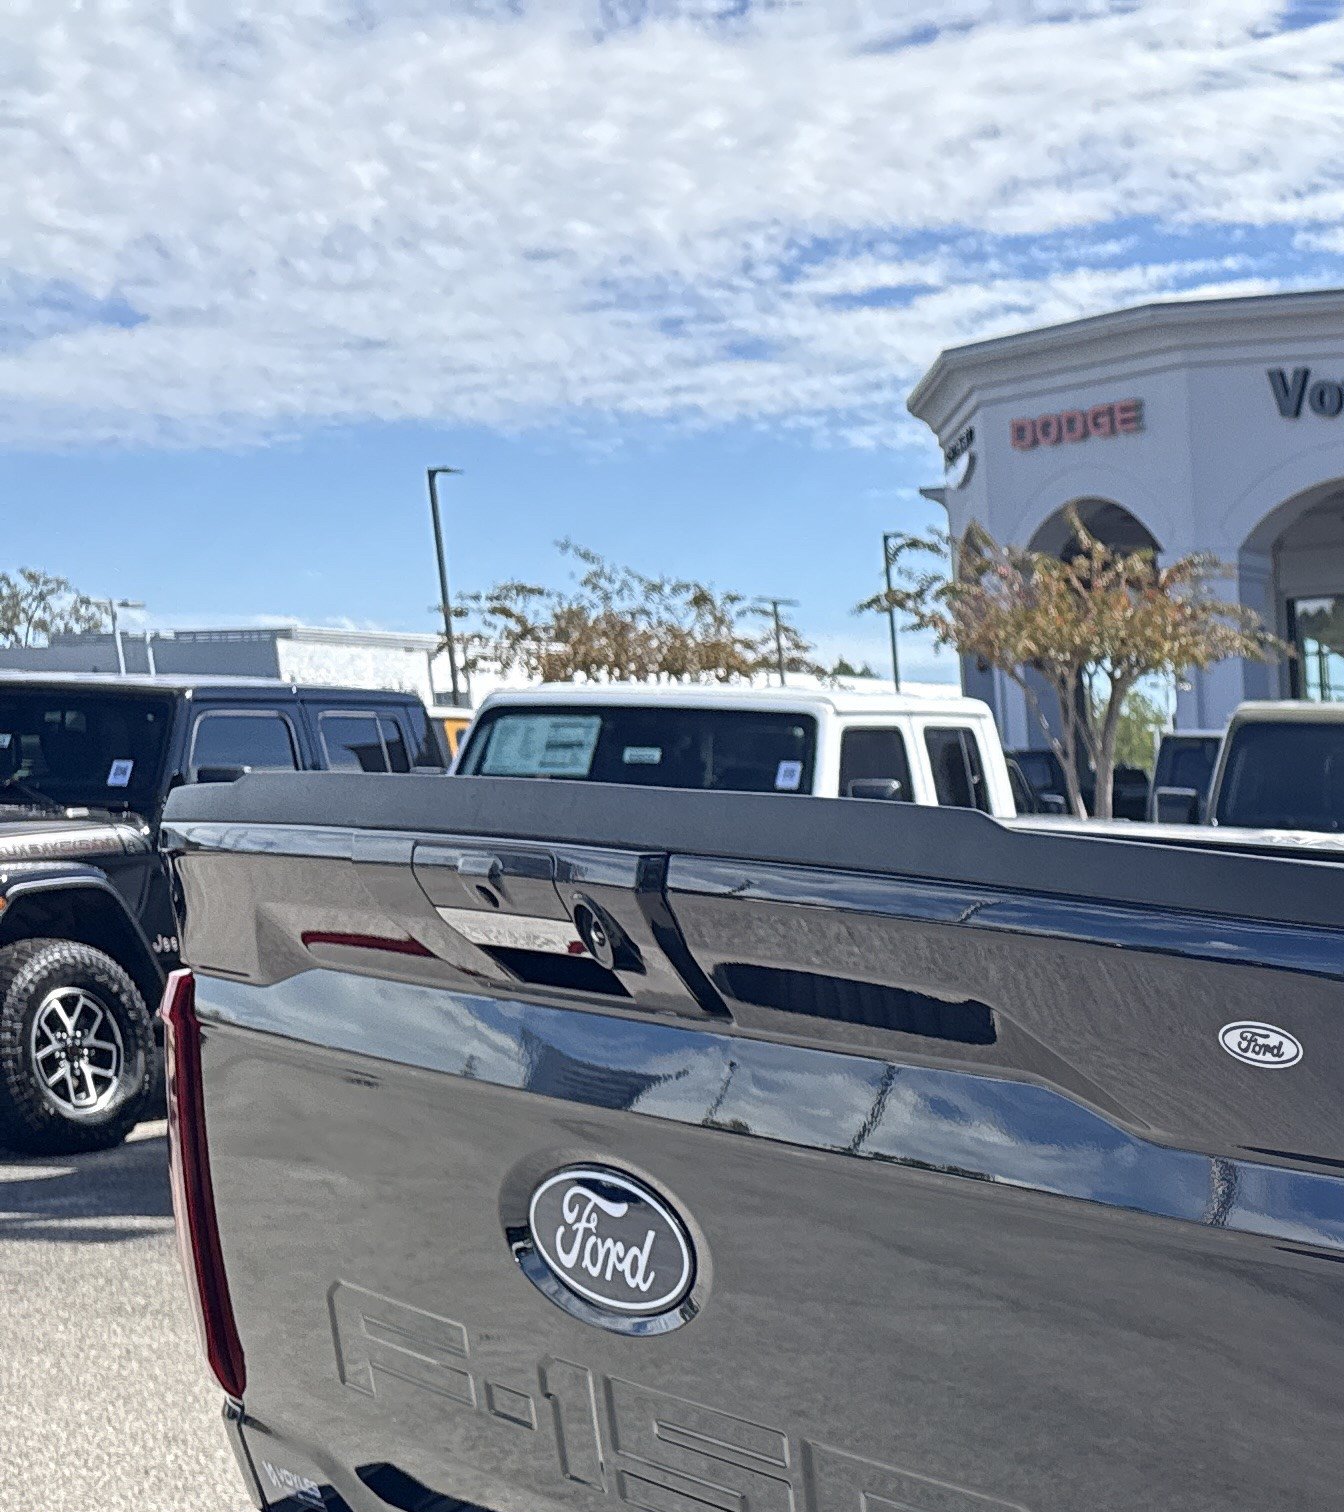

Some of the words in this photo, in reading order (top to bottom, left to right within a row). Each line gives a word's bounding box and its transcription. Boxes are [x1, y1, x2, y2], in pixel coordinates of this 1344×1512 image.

[1011, 397, 1145, 451] DODGE
[152, 933, 179, 954] Jee
[1238, 1030, 1284, 1058] Ford
[555, 1185, 656, 1292] Ford
